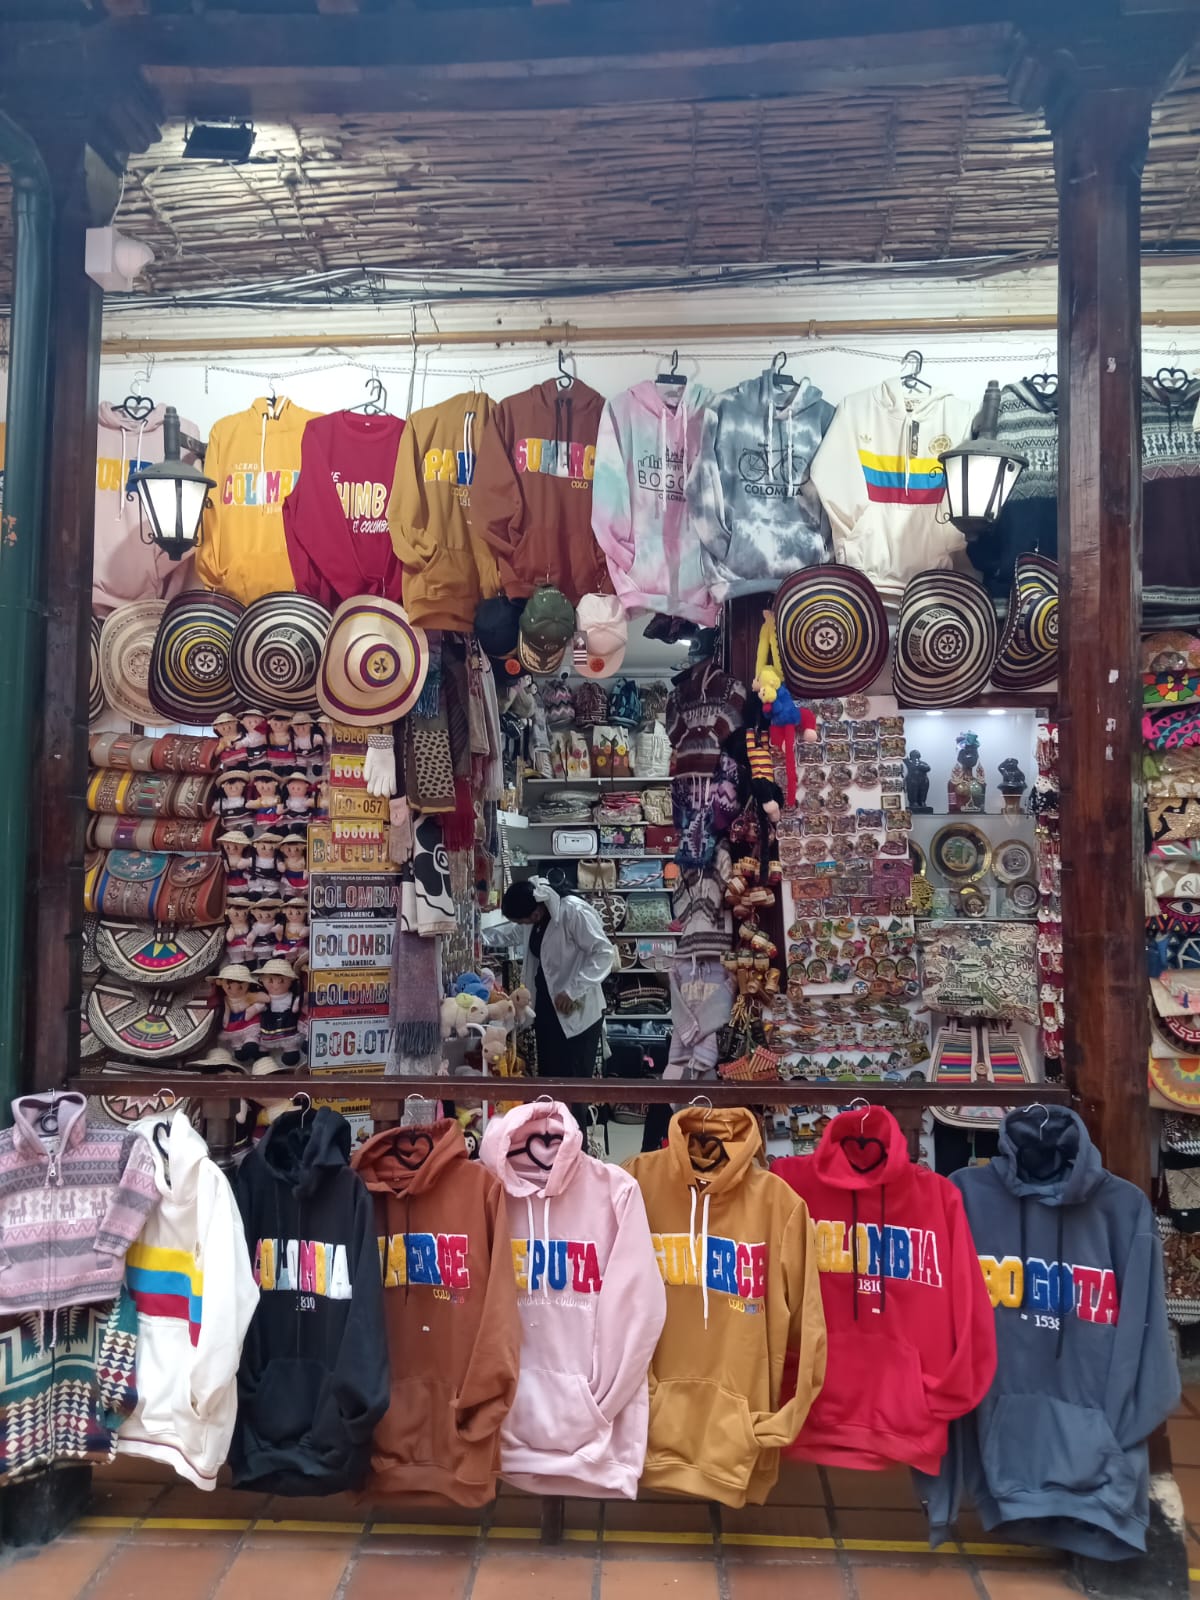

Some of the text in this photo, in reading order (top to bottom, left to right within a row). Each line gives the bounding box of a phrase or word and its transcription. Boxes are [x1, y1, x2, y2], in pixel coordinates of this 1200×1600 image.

[335, 728, 368, 744] COLO
[363, 800, 383, 813] 057
[313, 885, 399, 908] COLOMBIA
[810, 1219, 942, 1288] OLOMBIA
